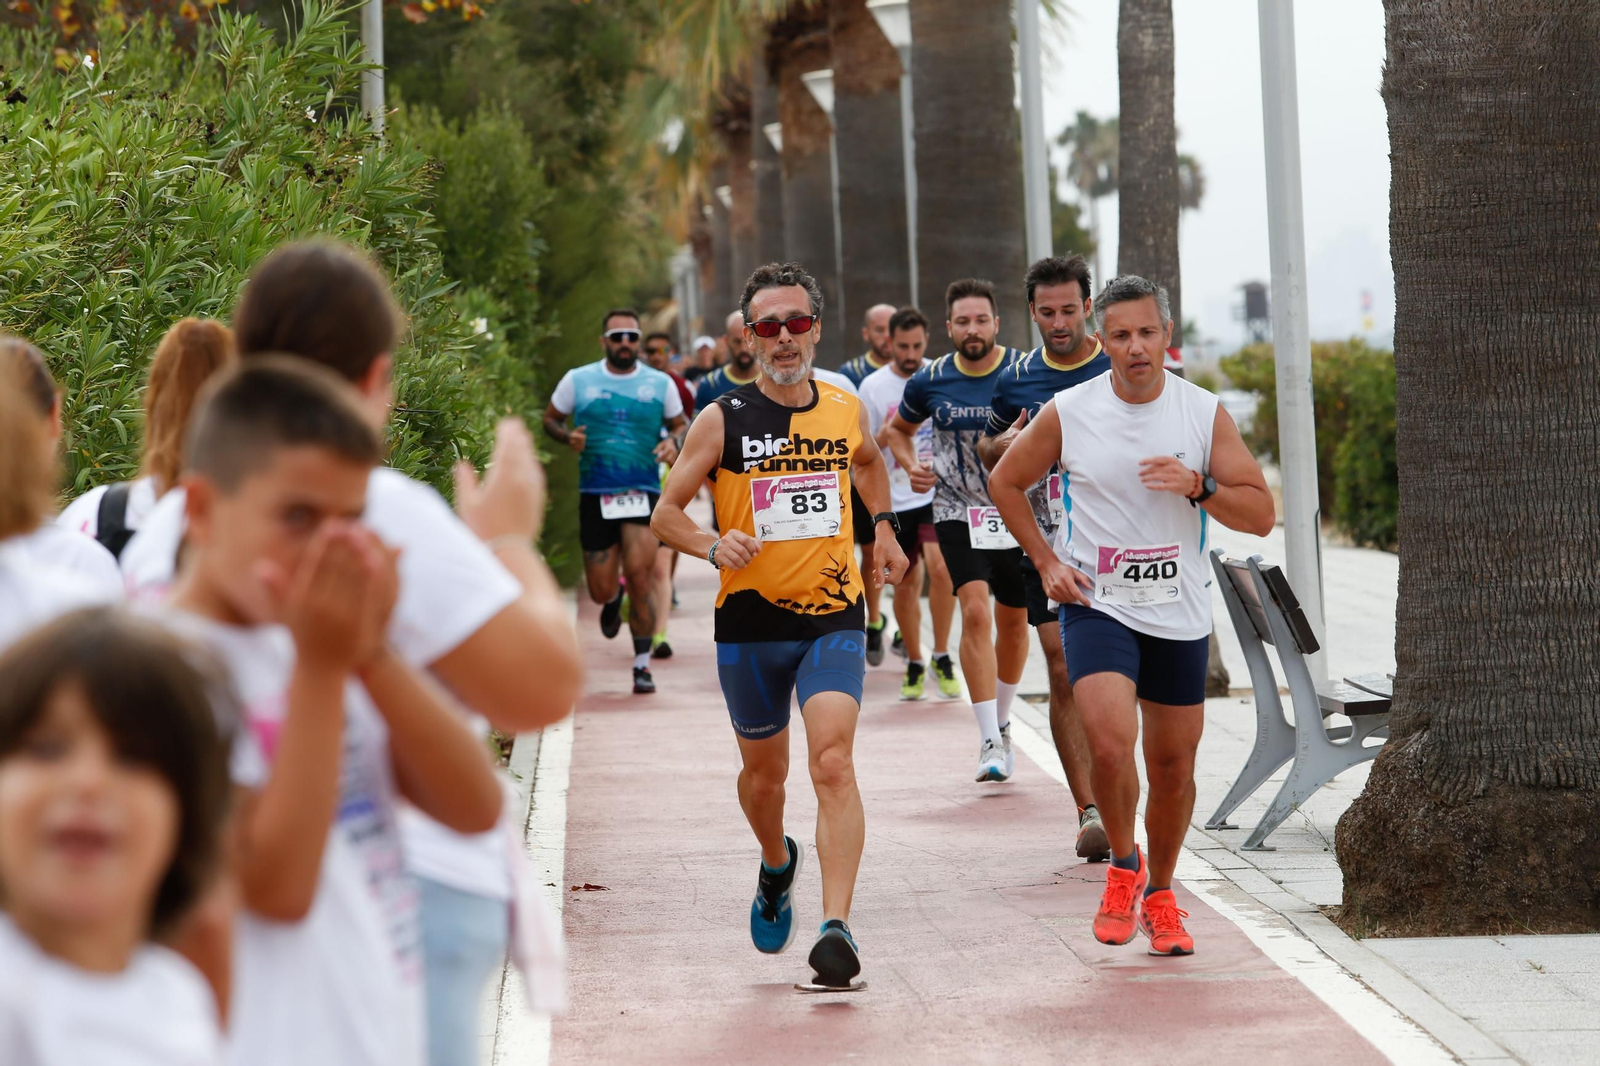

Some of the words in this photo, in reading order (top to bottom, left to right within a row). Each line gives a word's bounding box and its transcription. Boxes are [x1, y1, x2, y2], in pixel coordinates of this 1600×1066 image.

[741, 433, 849, 459] bichos
[743, 457, 849, 474] runners
[791, 492, 828, 515] 83
[1123, 560, 1178, 583] 440
[740, 723, 778, 734] LURBEL
